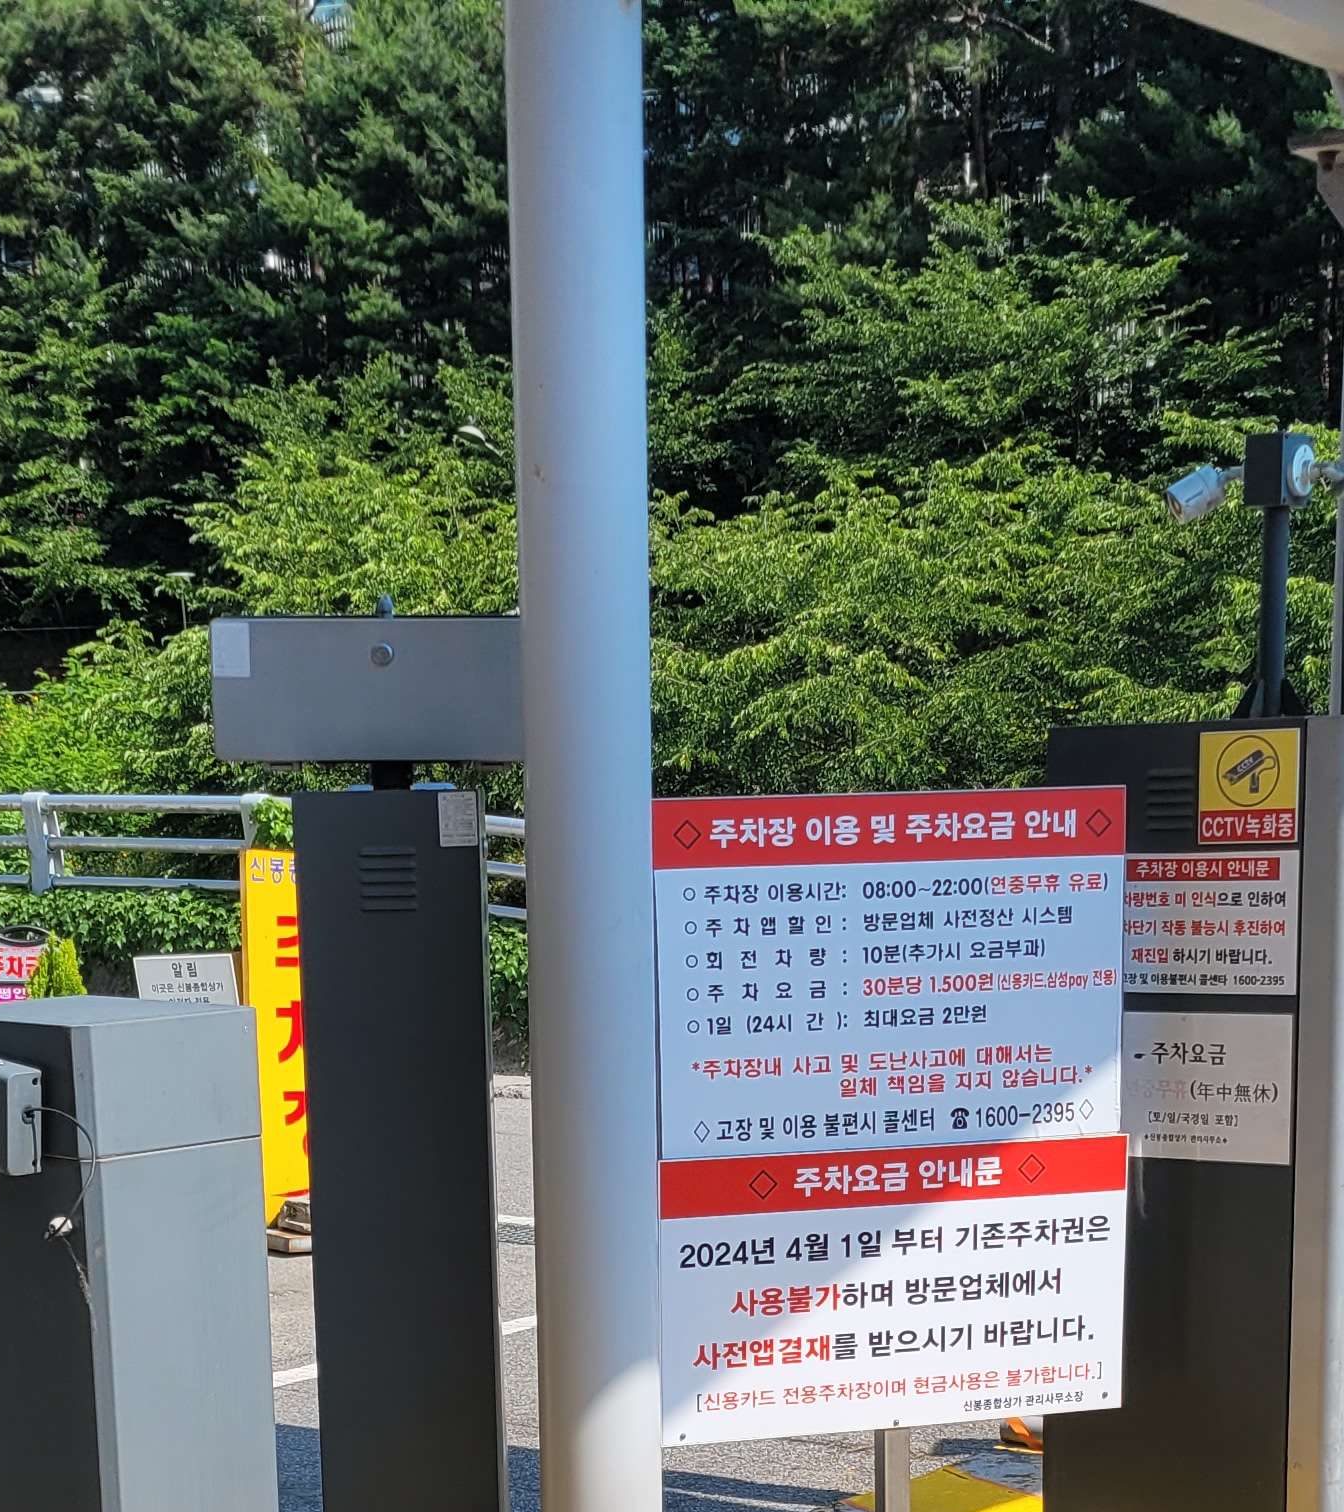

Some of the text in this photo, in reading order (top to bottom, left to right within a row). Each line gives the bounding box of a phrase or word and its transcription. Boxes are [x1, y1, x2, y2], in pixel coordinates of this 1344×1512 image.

[709, 808, 1077, 848] 주차장 이용 및 주차요금 안내
[1202, 814, 1293, 838] CCTV녹화중
[1136, 860, 1270, 878] 주차장 이용시 안내문
[703, 884, 759, 905] 주차장
[768, 881, 847, 903] 이용시간:
[1068, 872, 1108, 893] 유료)
[1175, 892, 1186, 907] 미
[1191, 892, 1243, 907] 인식으로
[1248, 892, 1286, 907] 인하여
[862, 910, 935, 932] 방문업체
[943, 908, 1015, 929] 사전정산
[1022, 905, 1073, 926] 시스템
[1161, 921, 1186, 936] 작동
[1191, 920, 1229, 936] 불능시
[1233, 920, 1286, 936] 후진하여
[862, 943, 962, 966] 10분(추가시
[969, 938, 1046, 961] 요금부과)
[1131, 948, 1272, 965] 재진입 하시기 바랍니다.
[862, 974, 923, 998] 30분당
[1093, 968, 1117, 988] 전용)
[1140, 974, 1148, 985] 및
[1151, 973, 1196, 986] 이용불편시
[1233, 975, 1285, 986] 1600-2395
[707, 1016, 733, 1036] 1일
[864, 1007, 936, 1029] 최대요금
[942, 1003, 987, 1026] 2만원
[792, 1054, 831, 1076] 사고
[841, 1053, 859, 1074] 및
[869, 1047, 966, 1072] 도난사고에
[976, 1043, 1053, 1066] 대해서는
[1151, 1042, 1226, 1066] 주차요금
[839, 1077, 877, 1099] 일체
[887, 1073, 946, 1096] 책임을
[955, 1070, 994, 1092] 지지
[716, 1099, 1076, 1143] 고장 및 이용 불편시 콜센터 1600-2395
[793, 1157, 1003, 1198] 주차요금 안내문
[679, 1215, 1111, 1270] 2024년 4월 1일 부터 기존주차권은
[731, 1268, 1063, 1318] 사용불가하며 방문업체에서
[693, 1315, 1094, 1371] 사전앱결재를 받으시기 바랍니다.
[783, 1378, 907, 1408] 전용주차장이며
[914, 1369, 1000, 1398] 현금사용은
[1006, 1361, 1102, 1388] 불가합니다.]
[963, 1389, 1084, 1414] 신봉종합상가 관리사무소장
